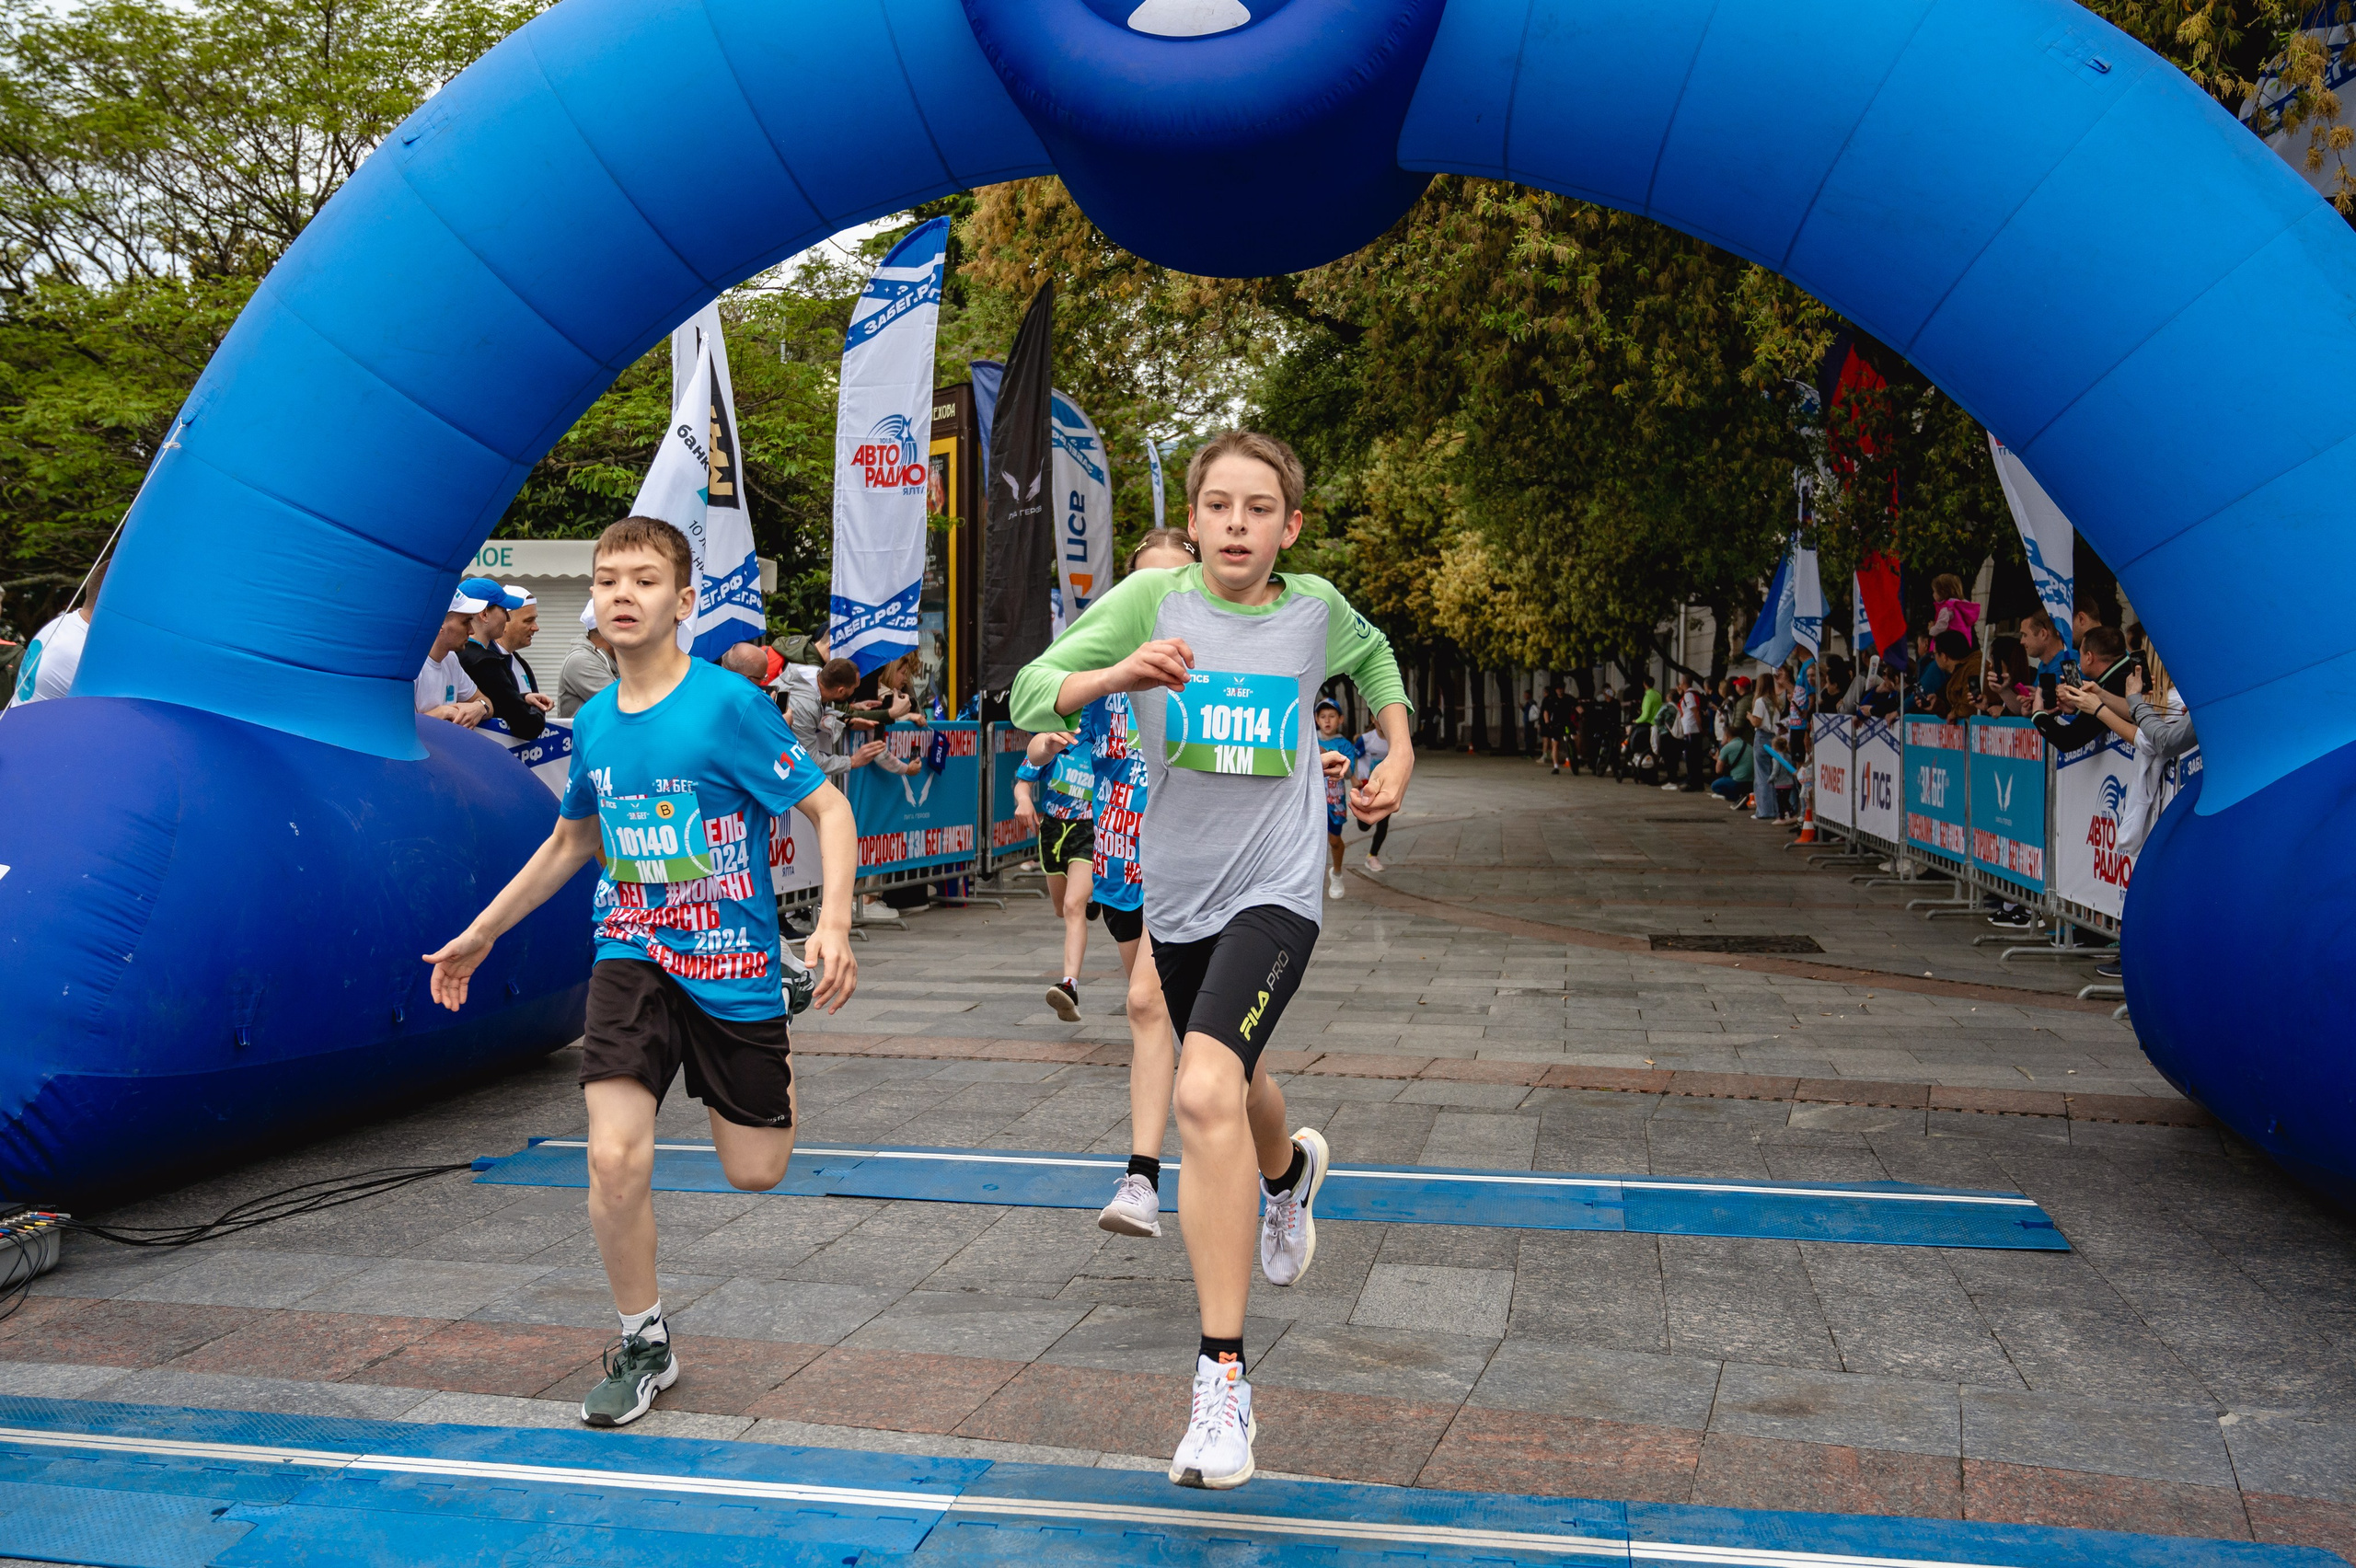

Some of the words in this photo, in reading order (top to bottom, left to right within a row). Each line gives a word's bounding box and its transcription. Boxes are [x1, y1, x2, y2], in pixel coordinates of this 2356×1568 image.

[933, 403, 955, 421] ЕХОВА
[850, 444, 900, 466] АВТО
[865, 464, 926, 488] РАДИО
[1200, 705, 1272, 743] 10114
[1214, 744, 1254, 775] 1KM
[1066, 767, 1095, 789] 10120
[1820, 764, 1845, 795] FONBET
[1872, 771, 1891, 811] ПСБ
[616, 825, 678, 857] 10140
[702, 812, 747, 847] ЕЛЬ
[2086, 815, 2116, 850] АВТО
[710, 843, 750, 875] 024
[858, 832, 907, 867] ГОРДОСТЬ
[635, 859, 670, 883] 1KM
[782, 865, 795, 877] ЯЛТА
[2094, 847, 2131, 890] РАДИО
[693, 927, 751, 954] 2024
[646, 942, 769, 980] #ЕДИНСТВО
[1240, 990, 1269, 1041] FILA
[1266, 950, 1289, 991] PRO
